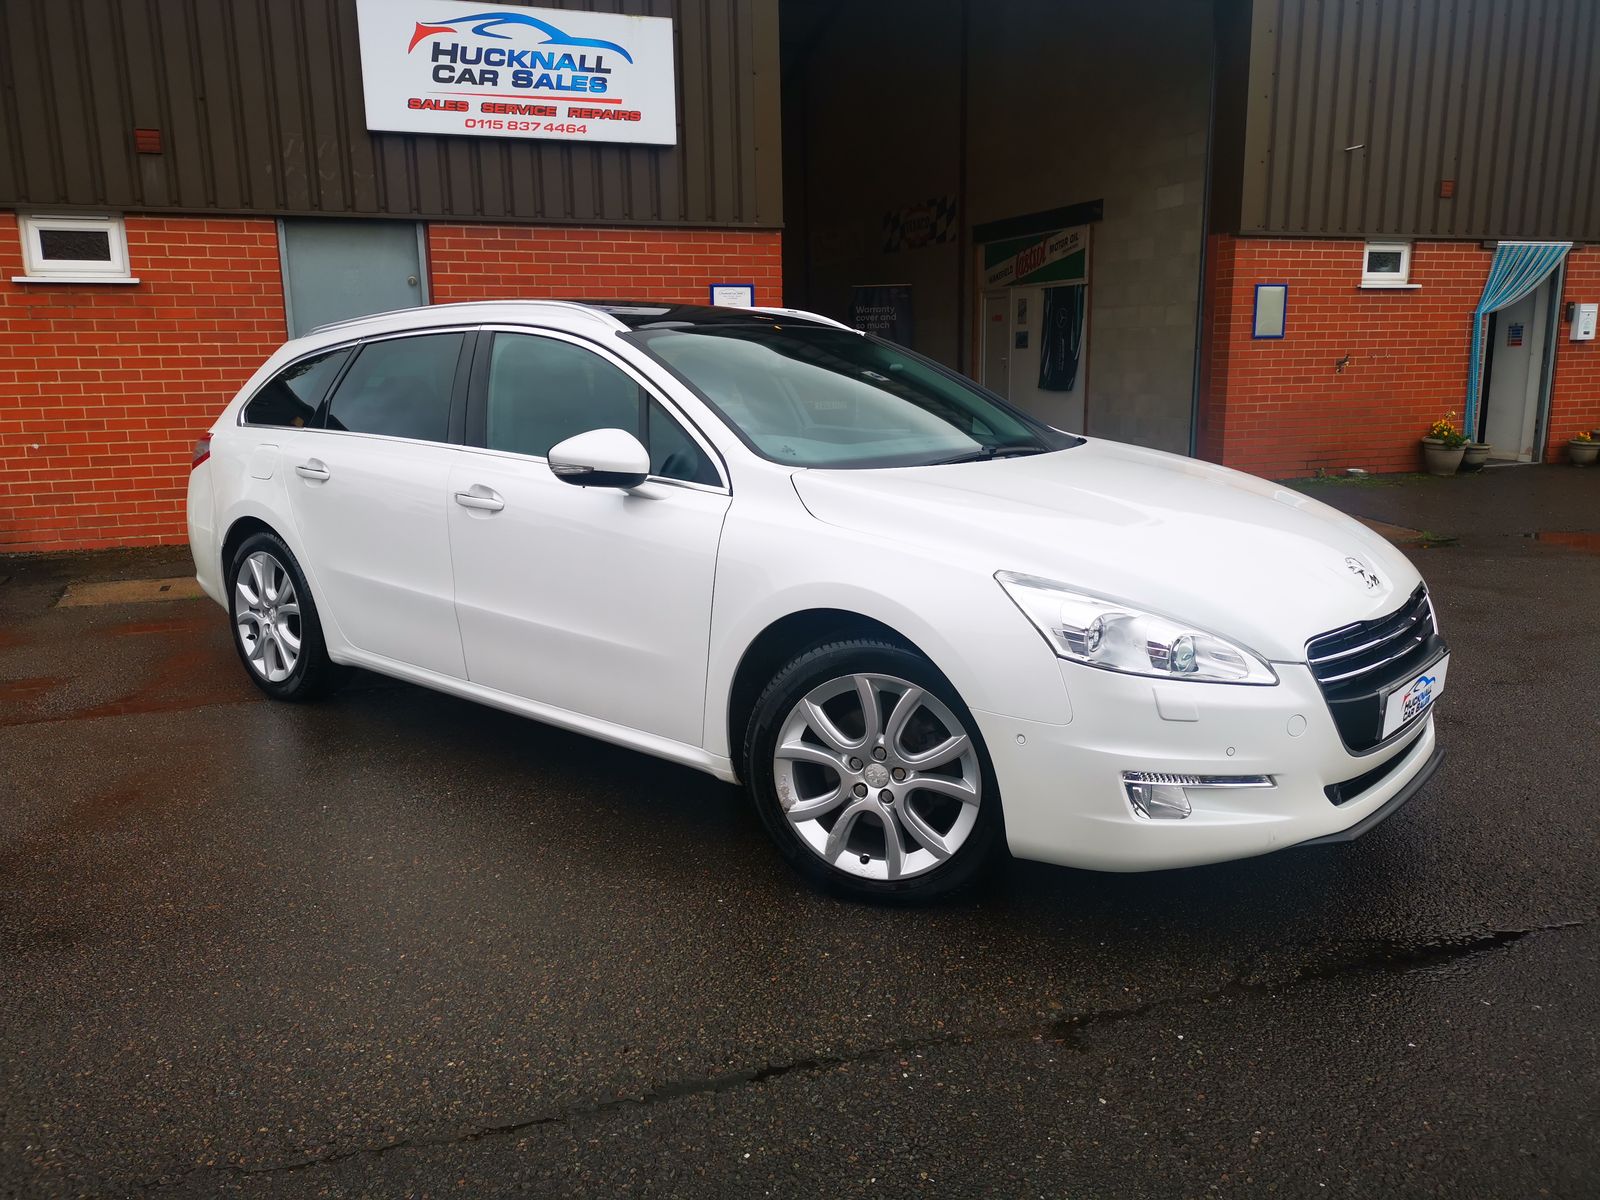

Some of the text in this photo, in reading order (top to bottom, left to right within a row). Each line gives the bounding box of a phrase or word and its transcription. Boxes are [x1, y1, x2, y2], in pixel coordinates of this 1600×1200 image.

[431, 41, 612, 75] HUCKNALL
[432, 64, 608, 93] CAR SALES
[407, 97, 642, 121] SALES SERVICE REPAIRS
[464, 118, 588, 134] 0115 837 4464
[855, 305, 895, 314] Warranty
[855, 313, 897, 322] cover and
[867, 321, 890, 329] much
